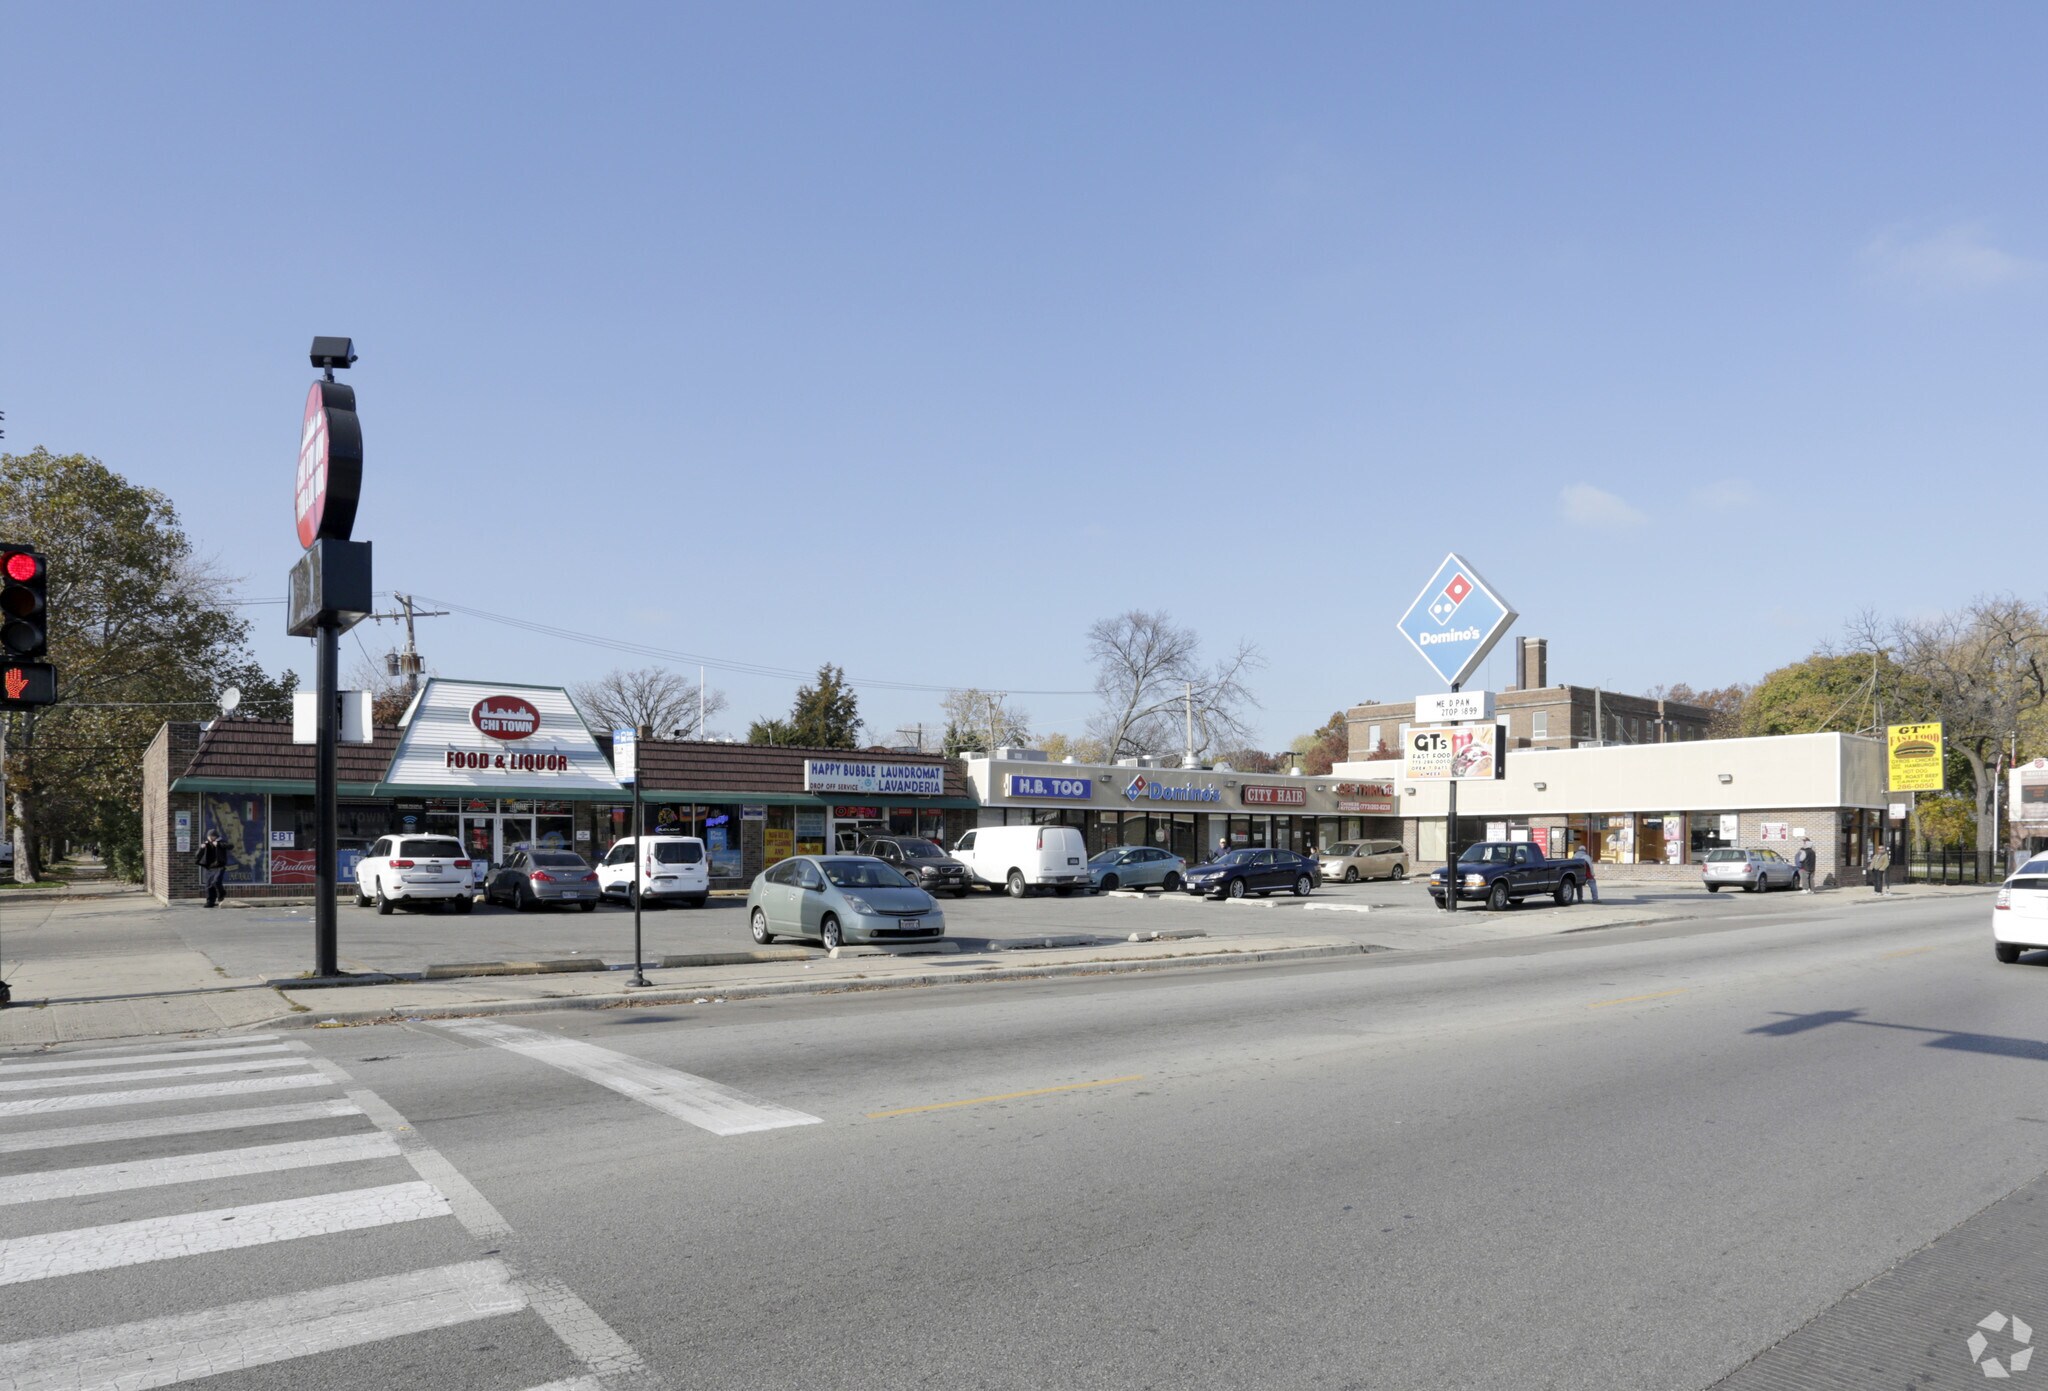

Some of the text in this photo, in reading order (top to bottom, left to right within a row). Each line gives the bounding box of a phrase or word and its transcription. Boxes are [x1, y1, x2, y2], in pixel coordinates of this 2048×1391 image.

[1420, 626, 1480, 645] Domino's
[480, 719, 532, 732] CHI TOWN
[1414, 734, 1447, 752] GTs
[1890, 734, 1940, 746] FAST FOOD
[445, 752, 567, 772] FOOD & LIQUOR
[812, 763, 940, 779] HAPPY BUBBLE LAUNDROMAT
[879, 780, 940, 792] LAVANDERIA
[1019, 779, 1084, 795] H.B. TOO
[1150, 782, 1221, 801] Domino's
[1248, 788, 1303, 803] CITY HAIR
[835, 807, 876, 817] OPEN
[272, 832, 294, 841] EBT
